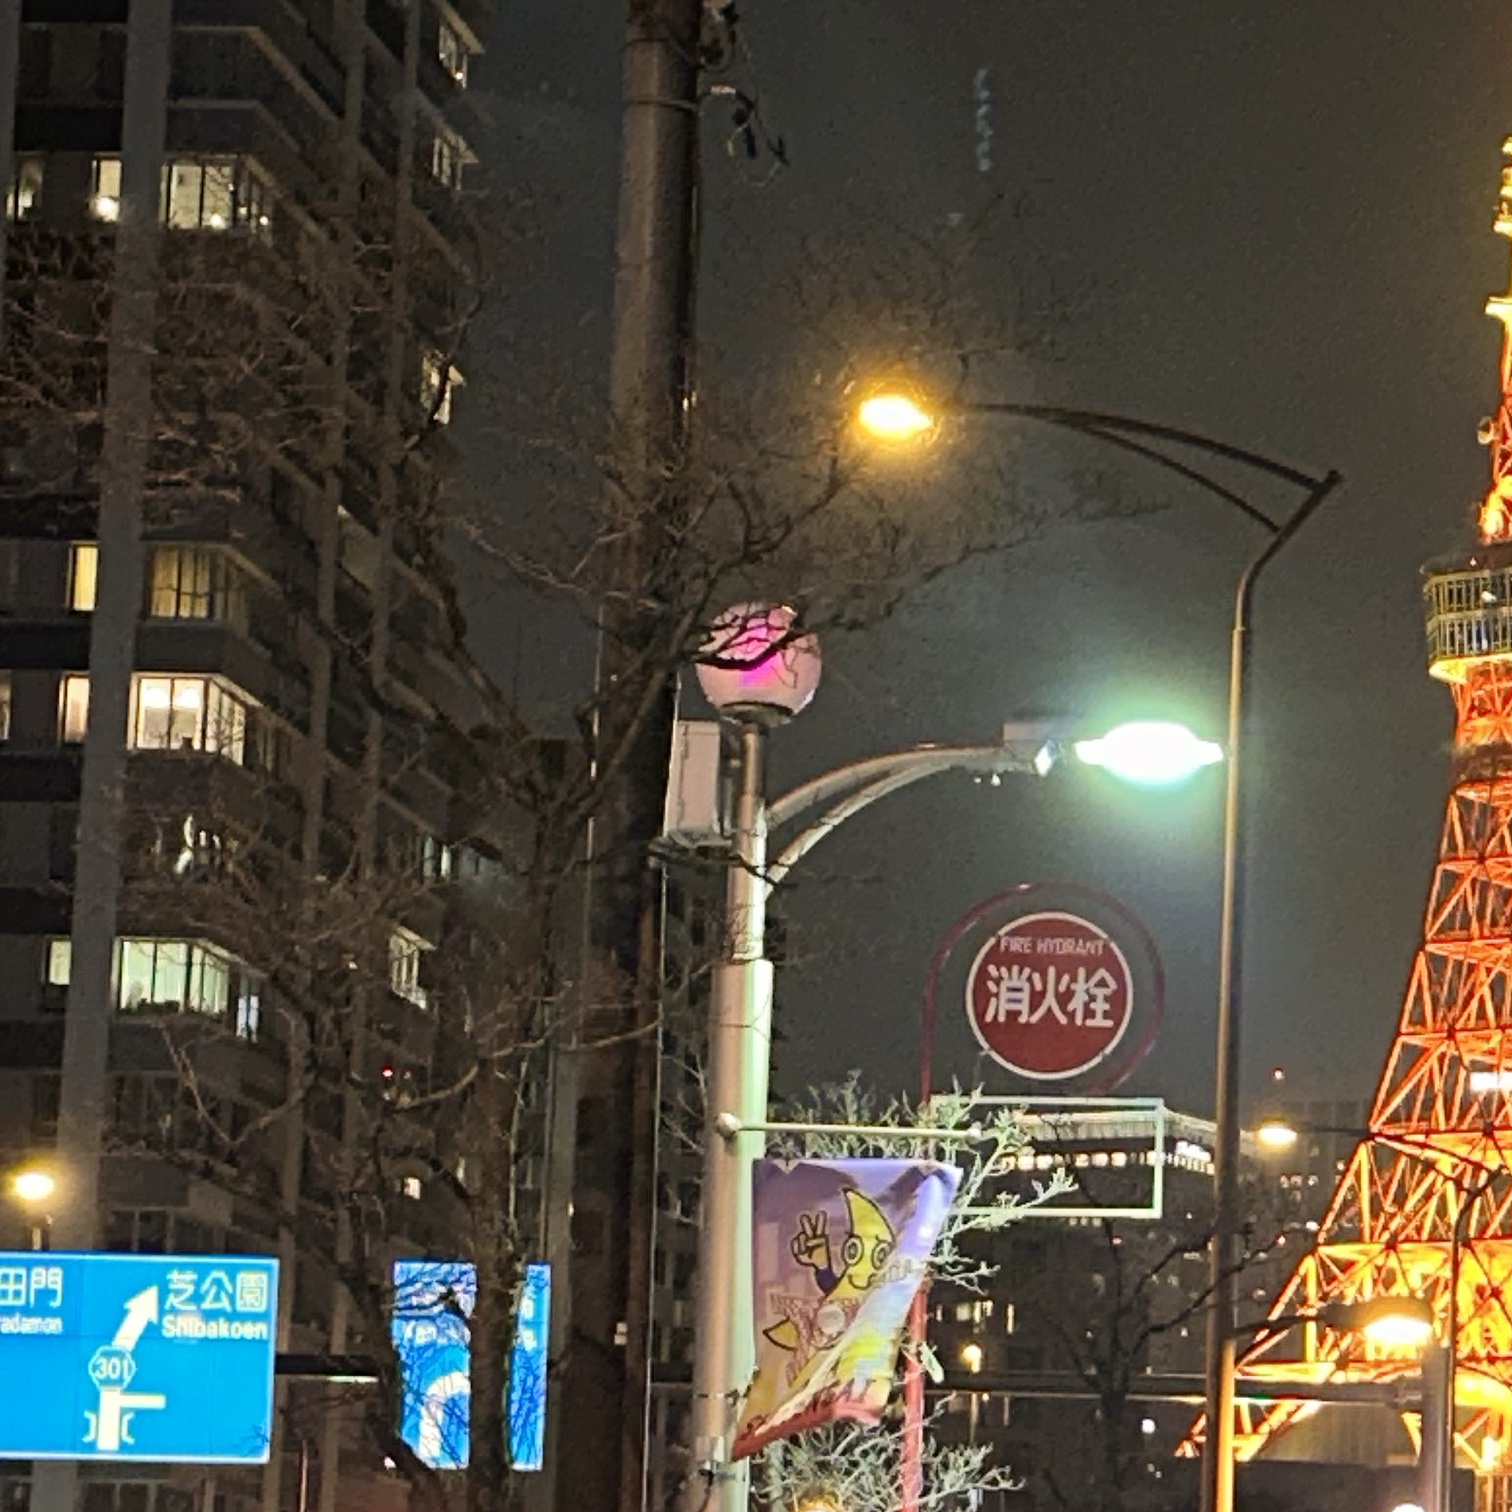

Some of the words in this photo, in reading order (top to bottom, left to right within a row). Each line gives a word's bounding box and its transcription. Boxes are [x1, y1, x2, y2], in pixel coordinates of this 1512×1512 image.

[1000, 936, 1032, 954] FIRE
[1037, 937, 1104, 957] HYDRANT
[984, 964, 1118, 1028] 消火栓
[164, 1269, 269, 1313] 芝公園
[162, 1313, 268, 1341] Shibakoen
[96, 1356, 130, 1380] 301
